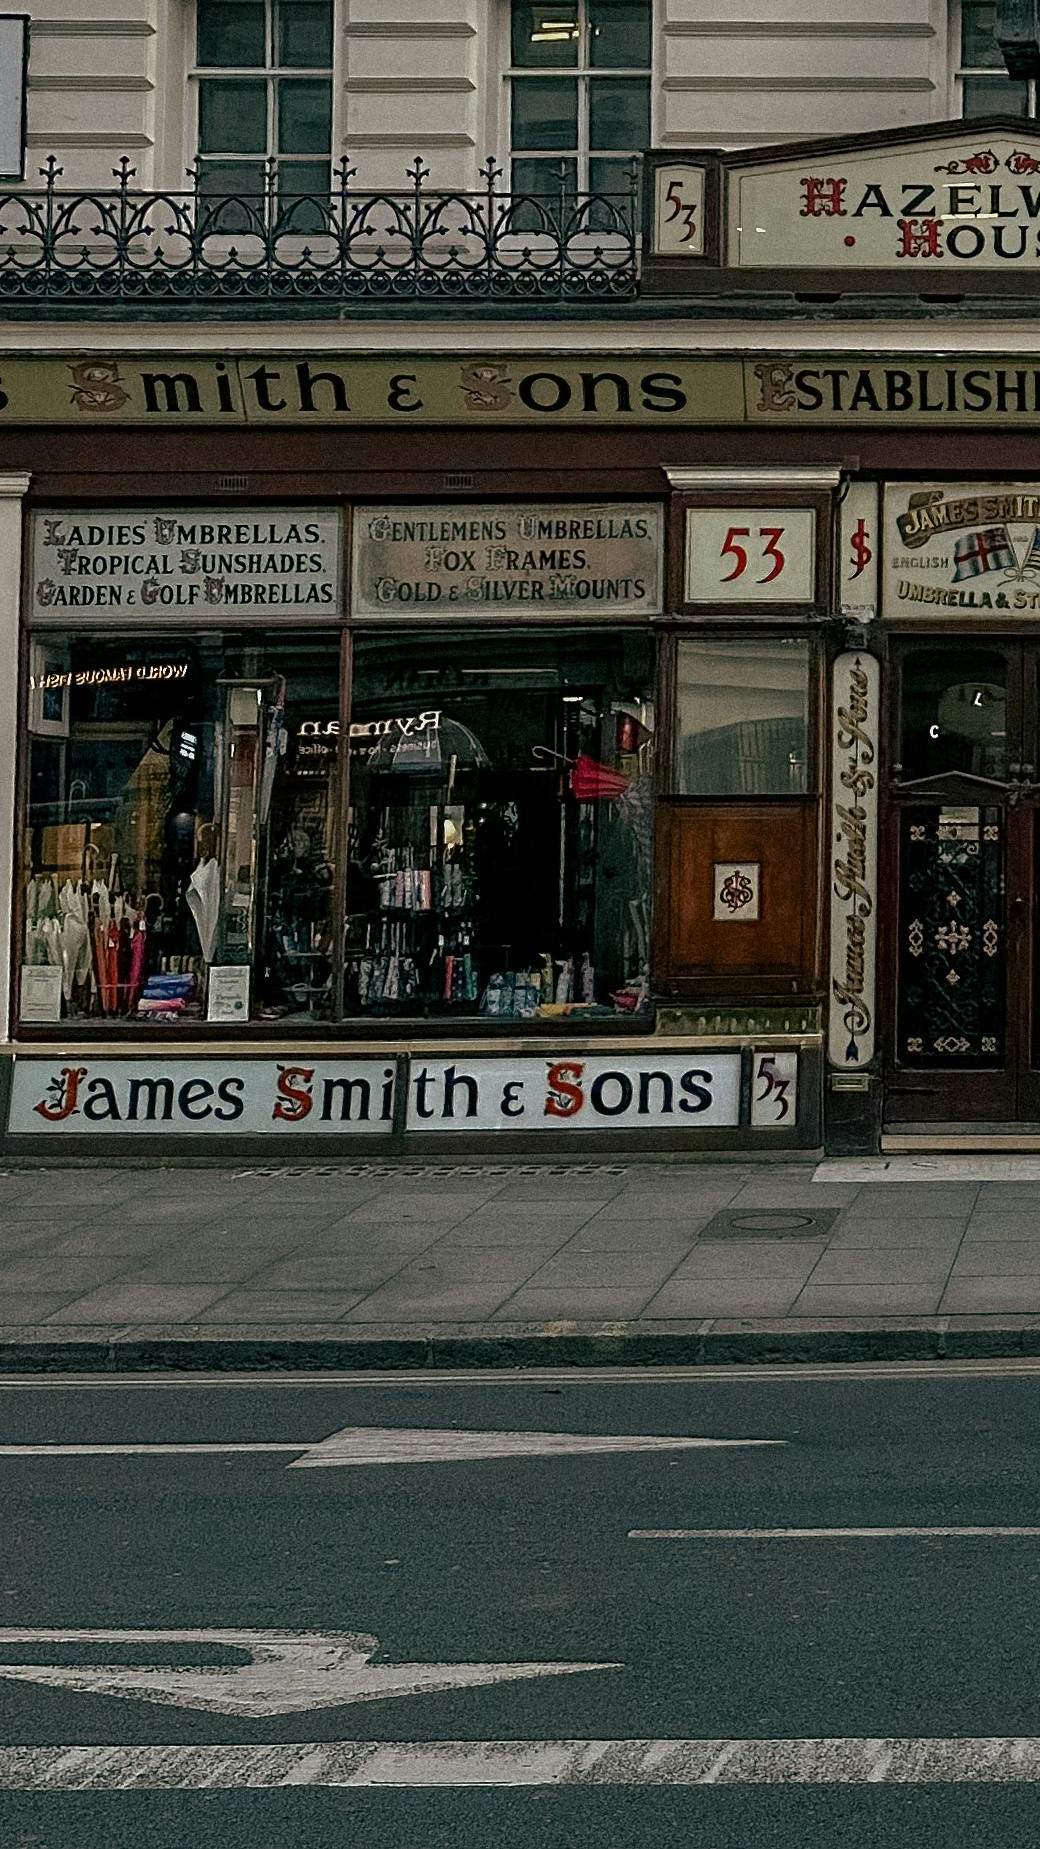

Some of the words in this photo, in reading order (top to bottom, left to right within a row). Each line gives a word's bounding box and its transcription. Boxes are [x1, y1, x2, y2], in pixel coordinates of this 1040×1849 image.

[666, 181, 697, 242] 53
[66, 360, 351, 414] Smith
[460, 361, 688, 414] Sons
[369, 515, 506, 542] GENTLEMENS
[905, 497, 978, 534] JAMES
[57, 548, 174, 576] TROPICAL
[424, 546, 475, 572] FOX
[720, 527, 784, 582] 53
[891, 556, 949, 569] ENGLISH
[36, 578, 122, 607] GARDEN
[141, 577, 201, 605] GOLF
[375, 576, 441, 602] GOLD
[465, 576, 544, 601] SILVER
[550, 574, 645, 600] MOUNTS
[897, 580, 993, 609] UMBRELLA
[832, 914, 871, 1036] James
[33, 1067, 244, 1121] James
[272, 1064, 478, 1121] Smith
[543, 1061, 713, 1118] Sons
[756, 1057, 789, 1120] 53
